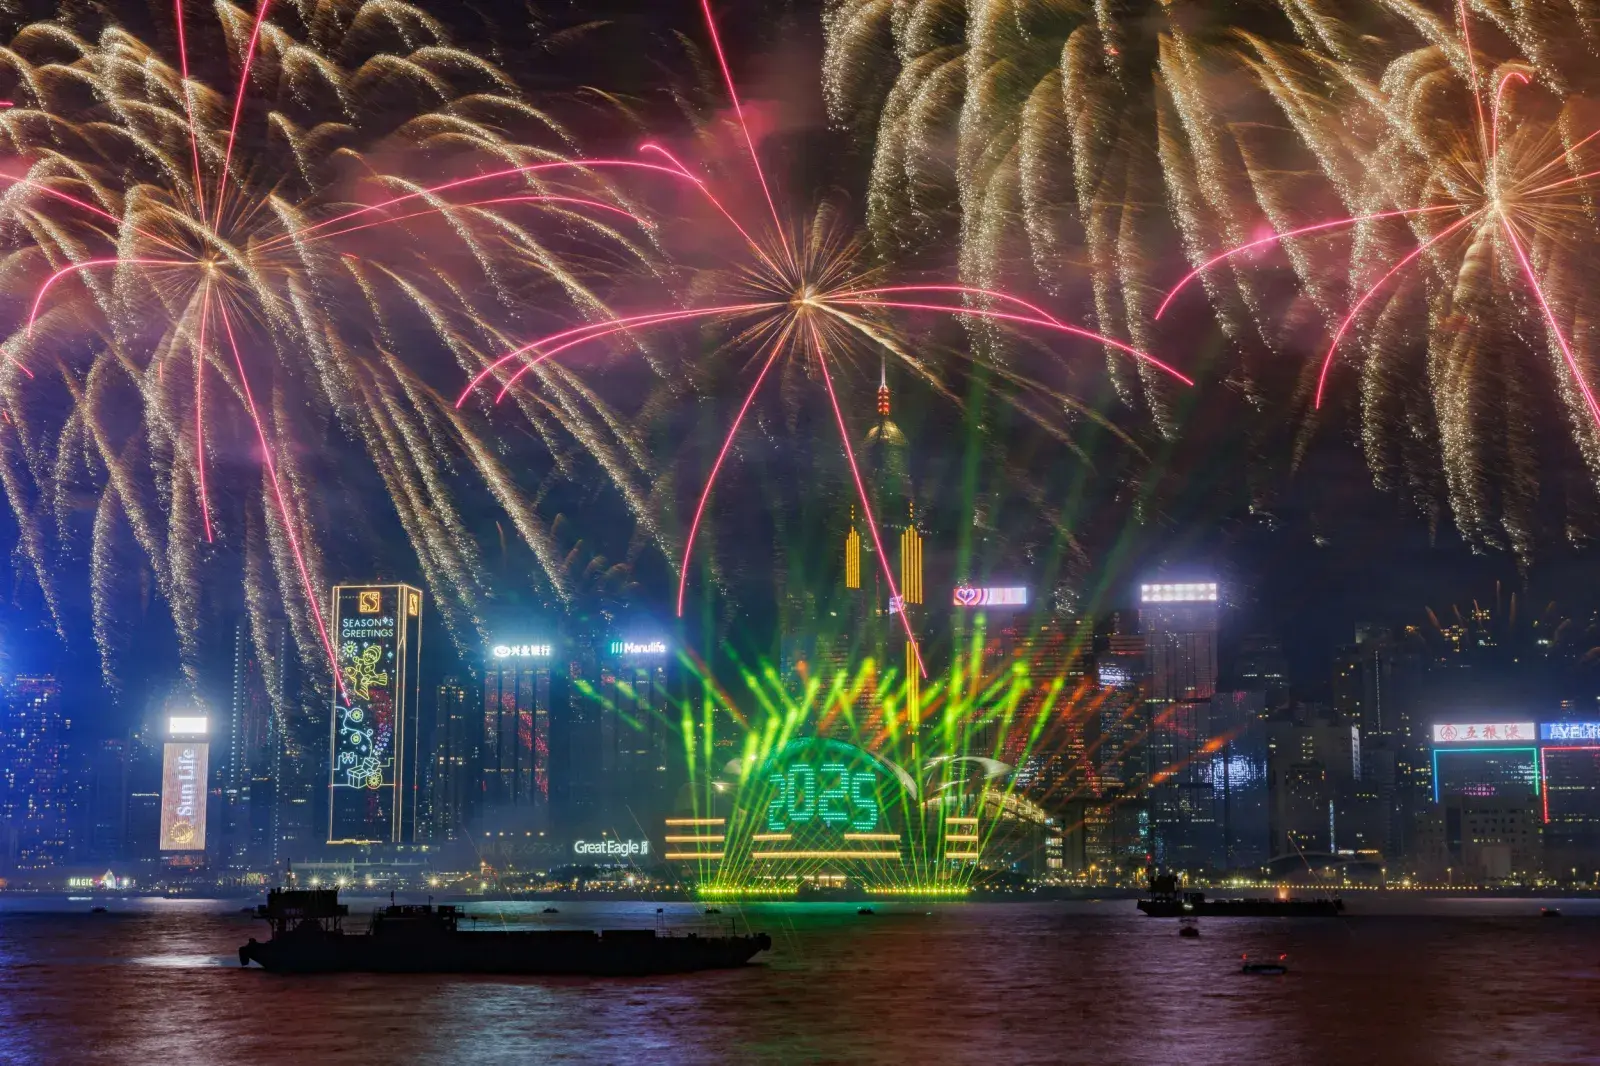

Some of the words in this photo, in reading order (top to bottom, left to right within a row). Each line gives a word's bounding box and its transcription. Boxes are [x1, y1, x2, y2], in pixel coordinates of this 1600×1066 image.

[342, 628, 394, 638] GREETINGS
[624, 641, 666, 653] Manulife
[179, 748, 195, 780] Life
[177, 784, 194, 816] Sun
[768, 763, 878, 831] 2025
[574, 840, 607, 855] Great
[608, 839, 639, 857] Eagle
[69, 878, 93, 886] MAGIC
